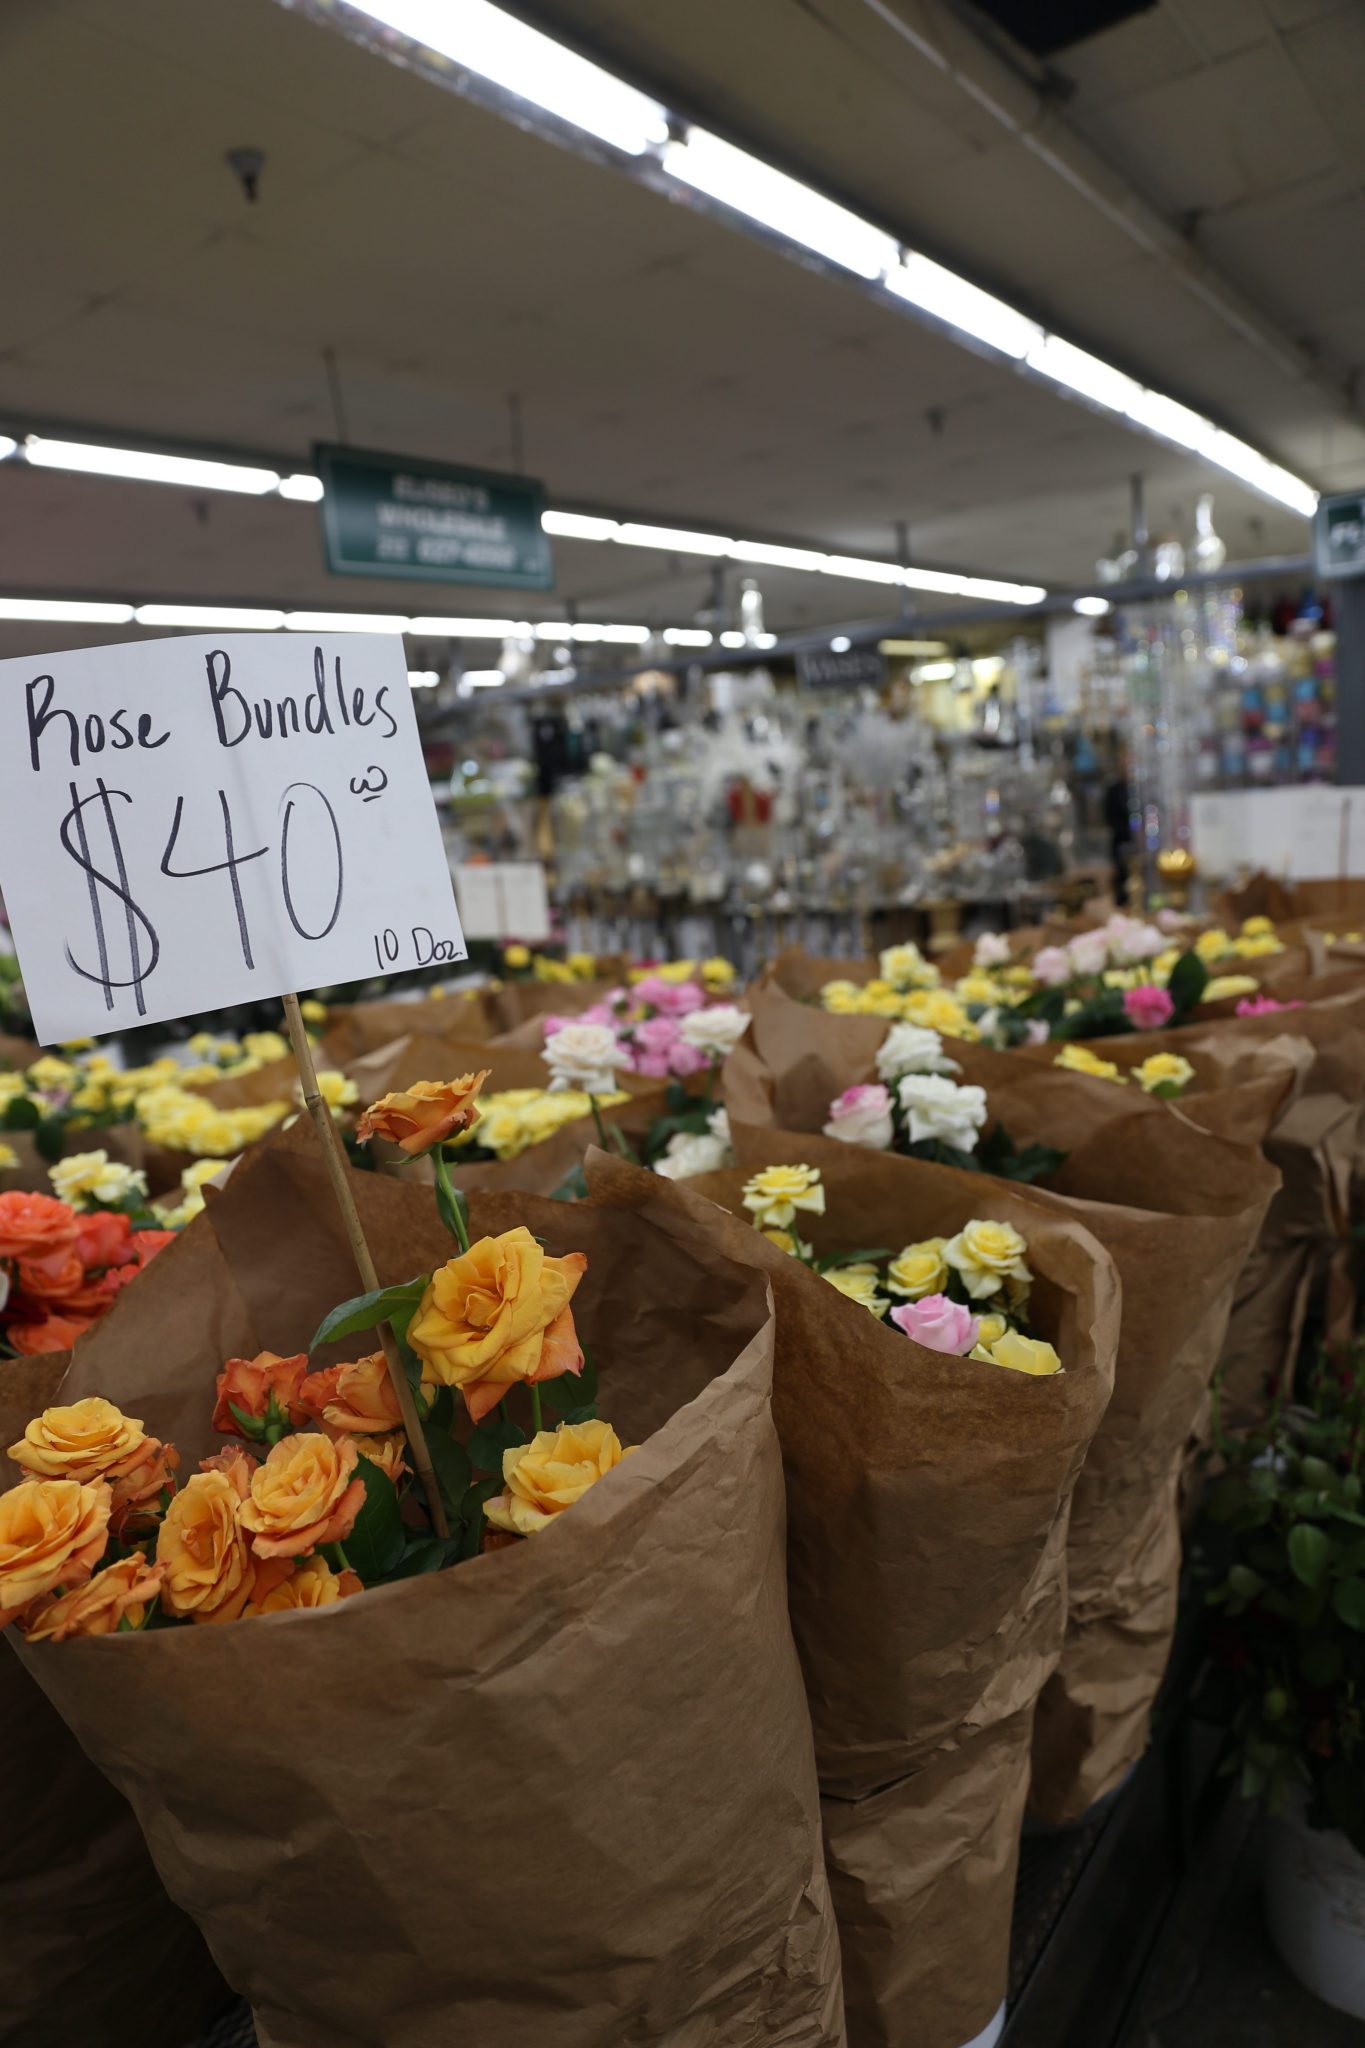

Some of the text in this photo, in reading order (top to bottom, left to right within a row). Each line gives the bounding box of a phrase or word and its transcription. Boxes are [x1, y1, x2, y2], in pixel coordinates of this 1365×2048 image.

[26, 647, 397, 771] Rose Bundles
[374, 929, 399, 970] 10
